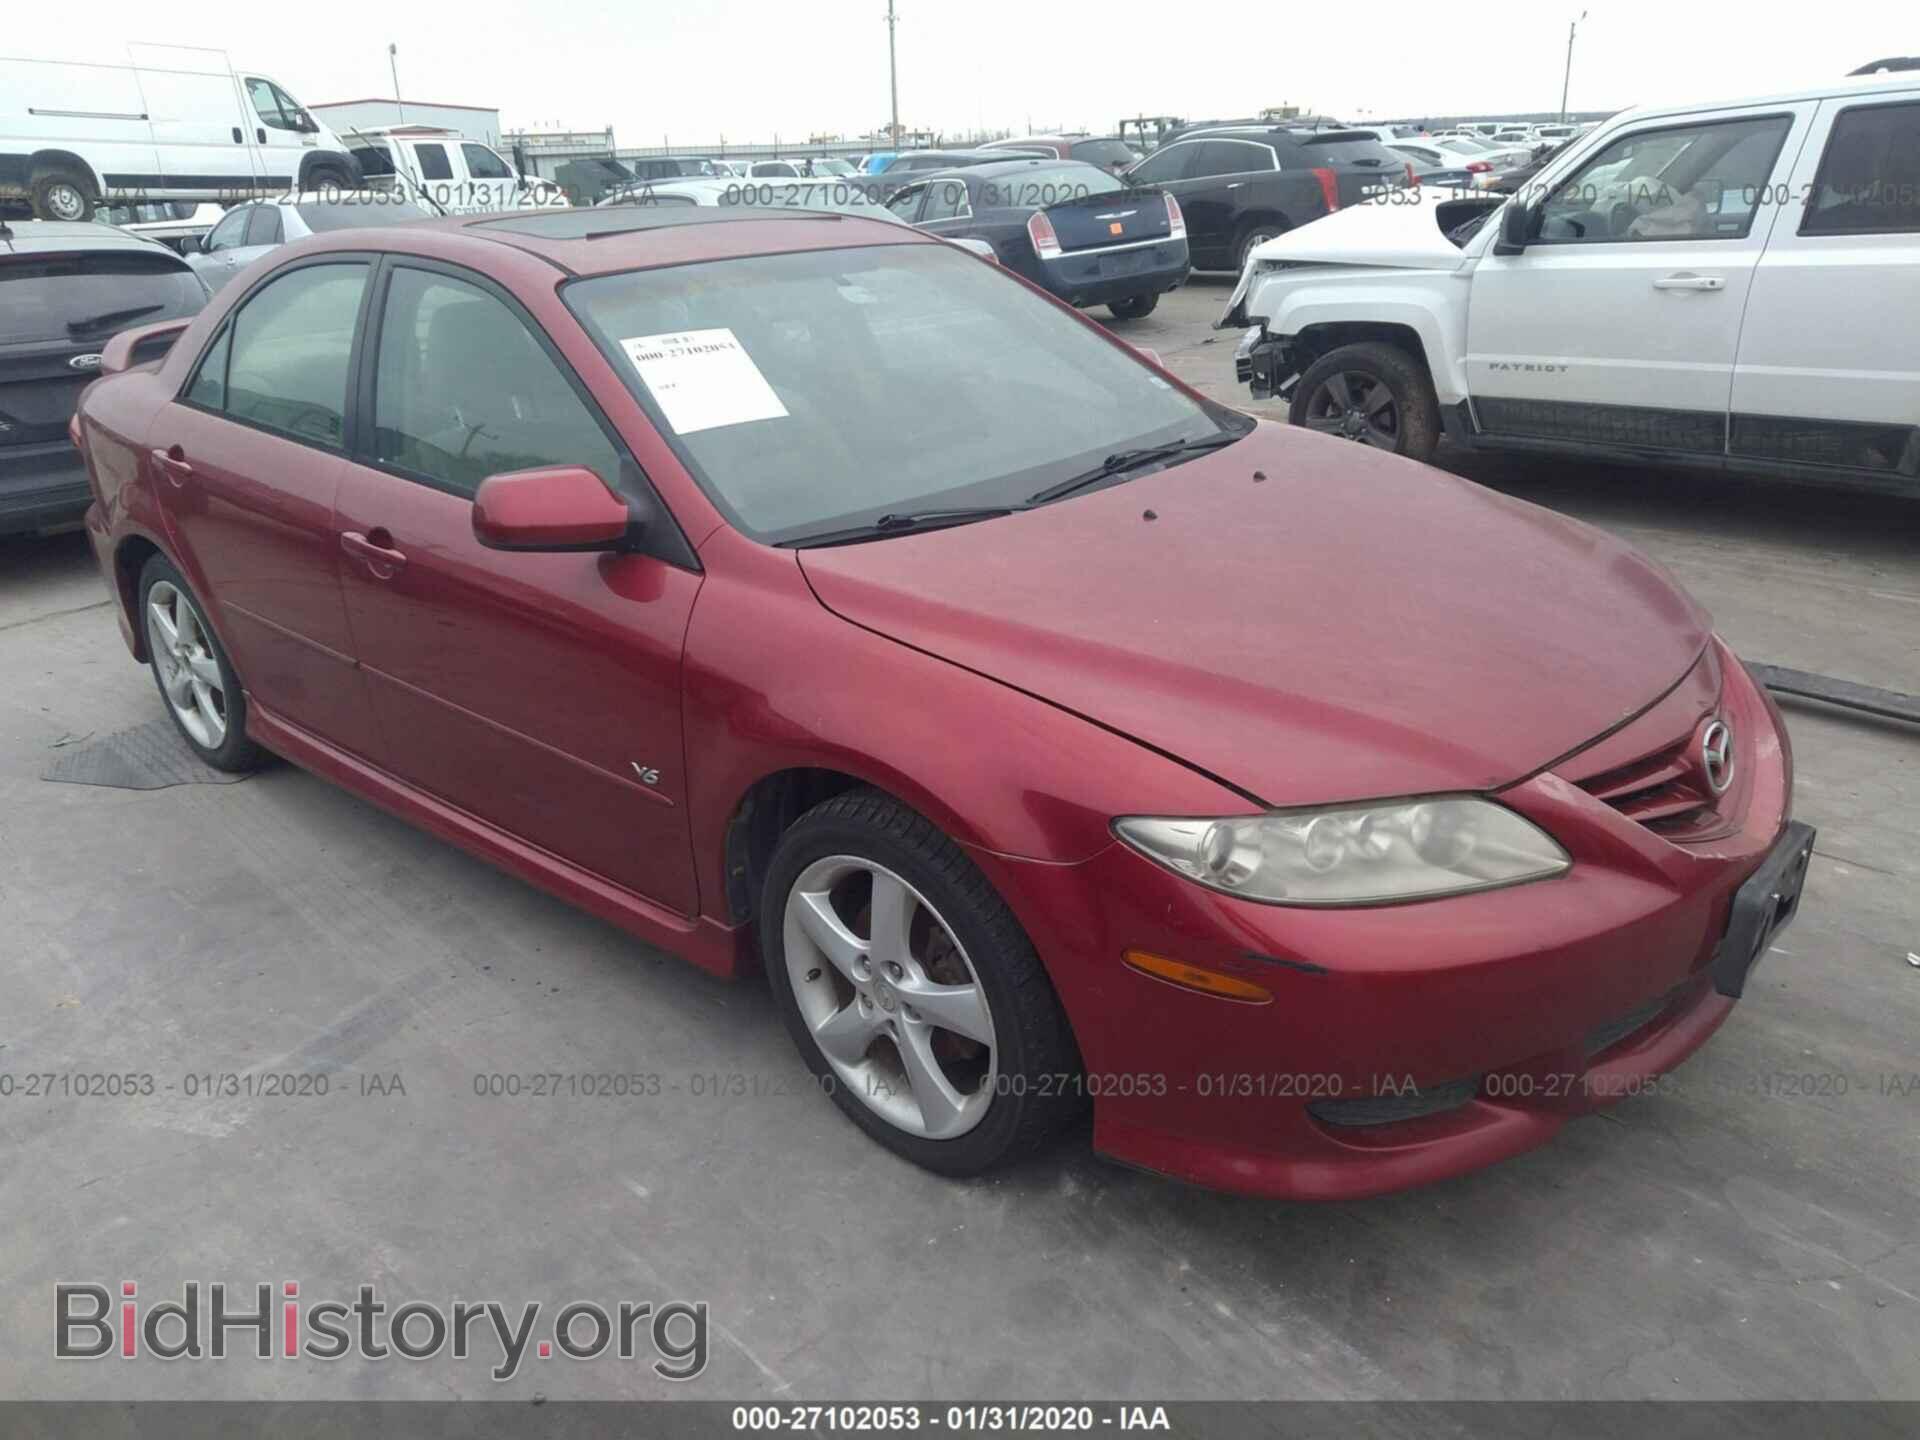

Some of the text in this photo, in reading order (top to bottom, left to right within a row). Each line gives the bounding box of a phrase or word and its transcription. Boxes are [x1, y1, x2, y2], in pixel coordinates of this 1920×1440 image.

[74, 354, 103, 368] Ford
[1488, 362, 1569, 374] PATRIOT
[631, 761, 659, 785] V6
